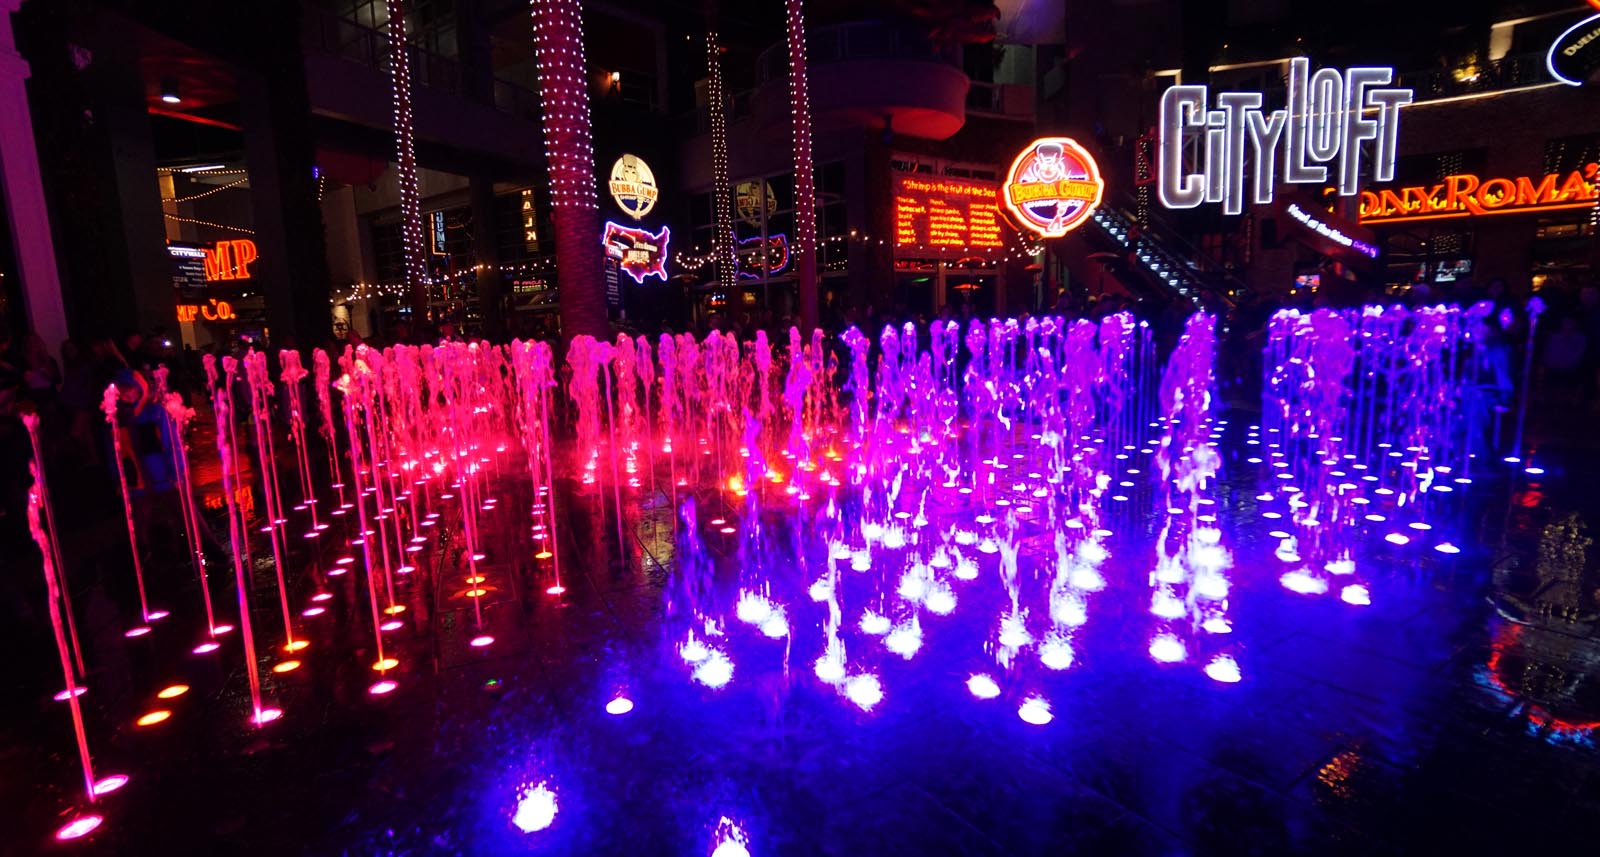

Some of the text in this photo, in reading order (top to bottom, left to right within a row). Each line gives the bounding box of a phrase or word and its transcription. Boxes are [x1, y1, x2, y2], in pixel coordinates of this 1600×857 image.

[611, 183, 657, 199] BUBBA GUMP
[1324, 162, 1599, 218] ONY ROMA'
